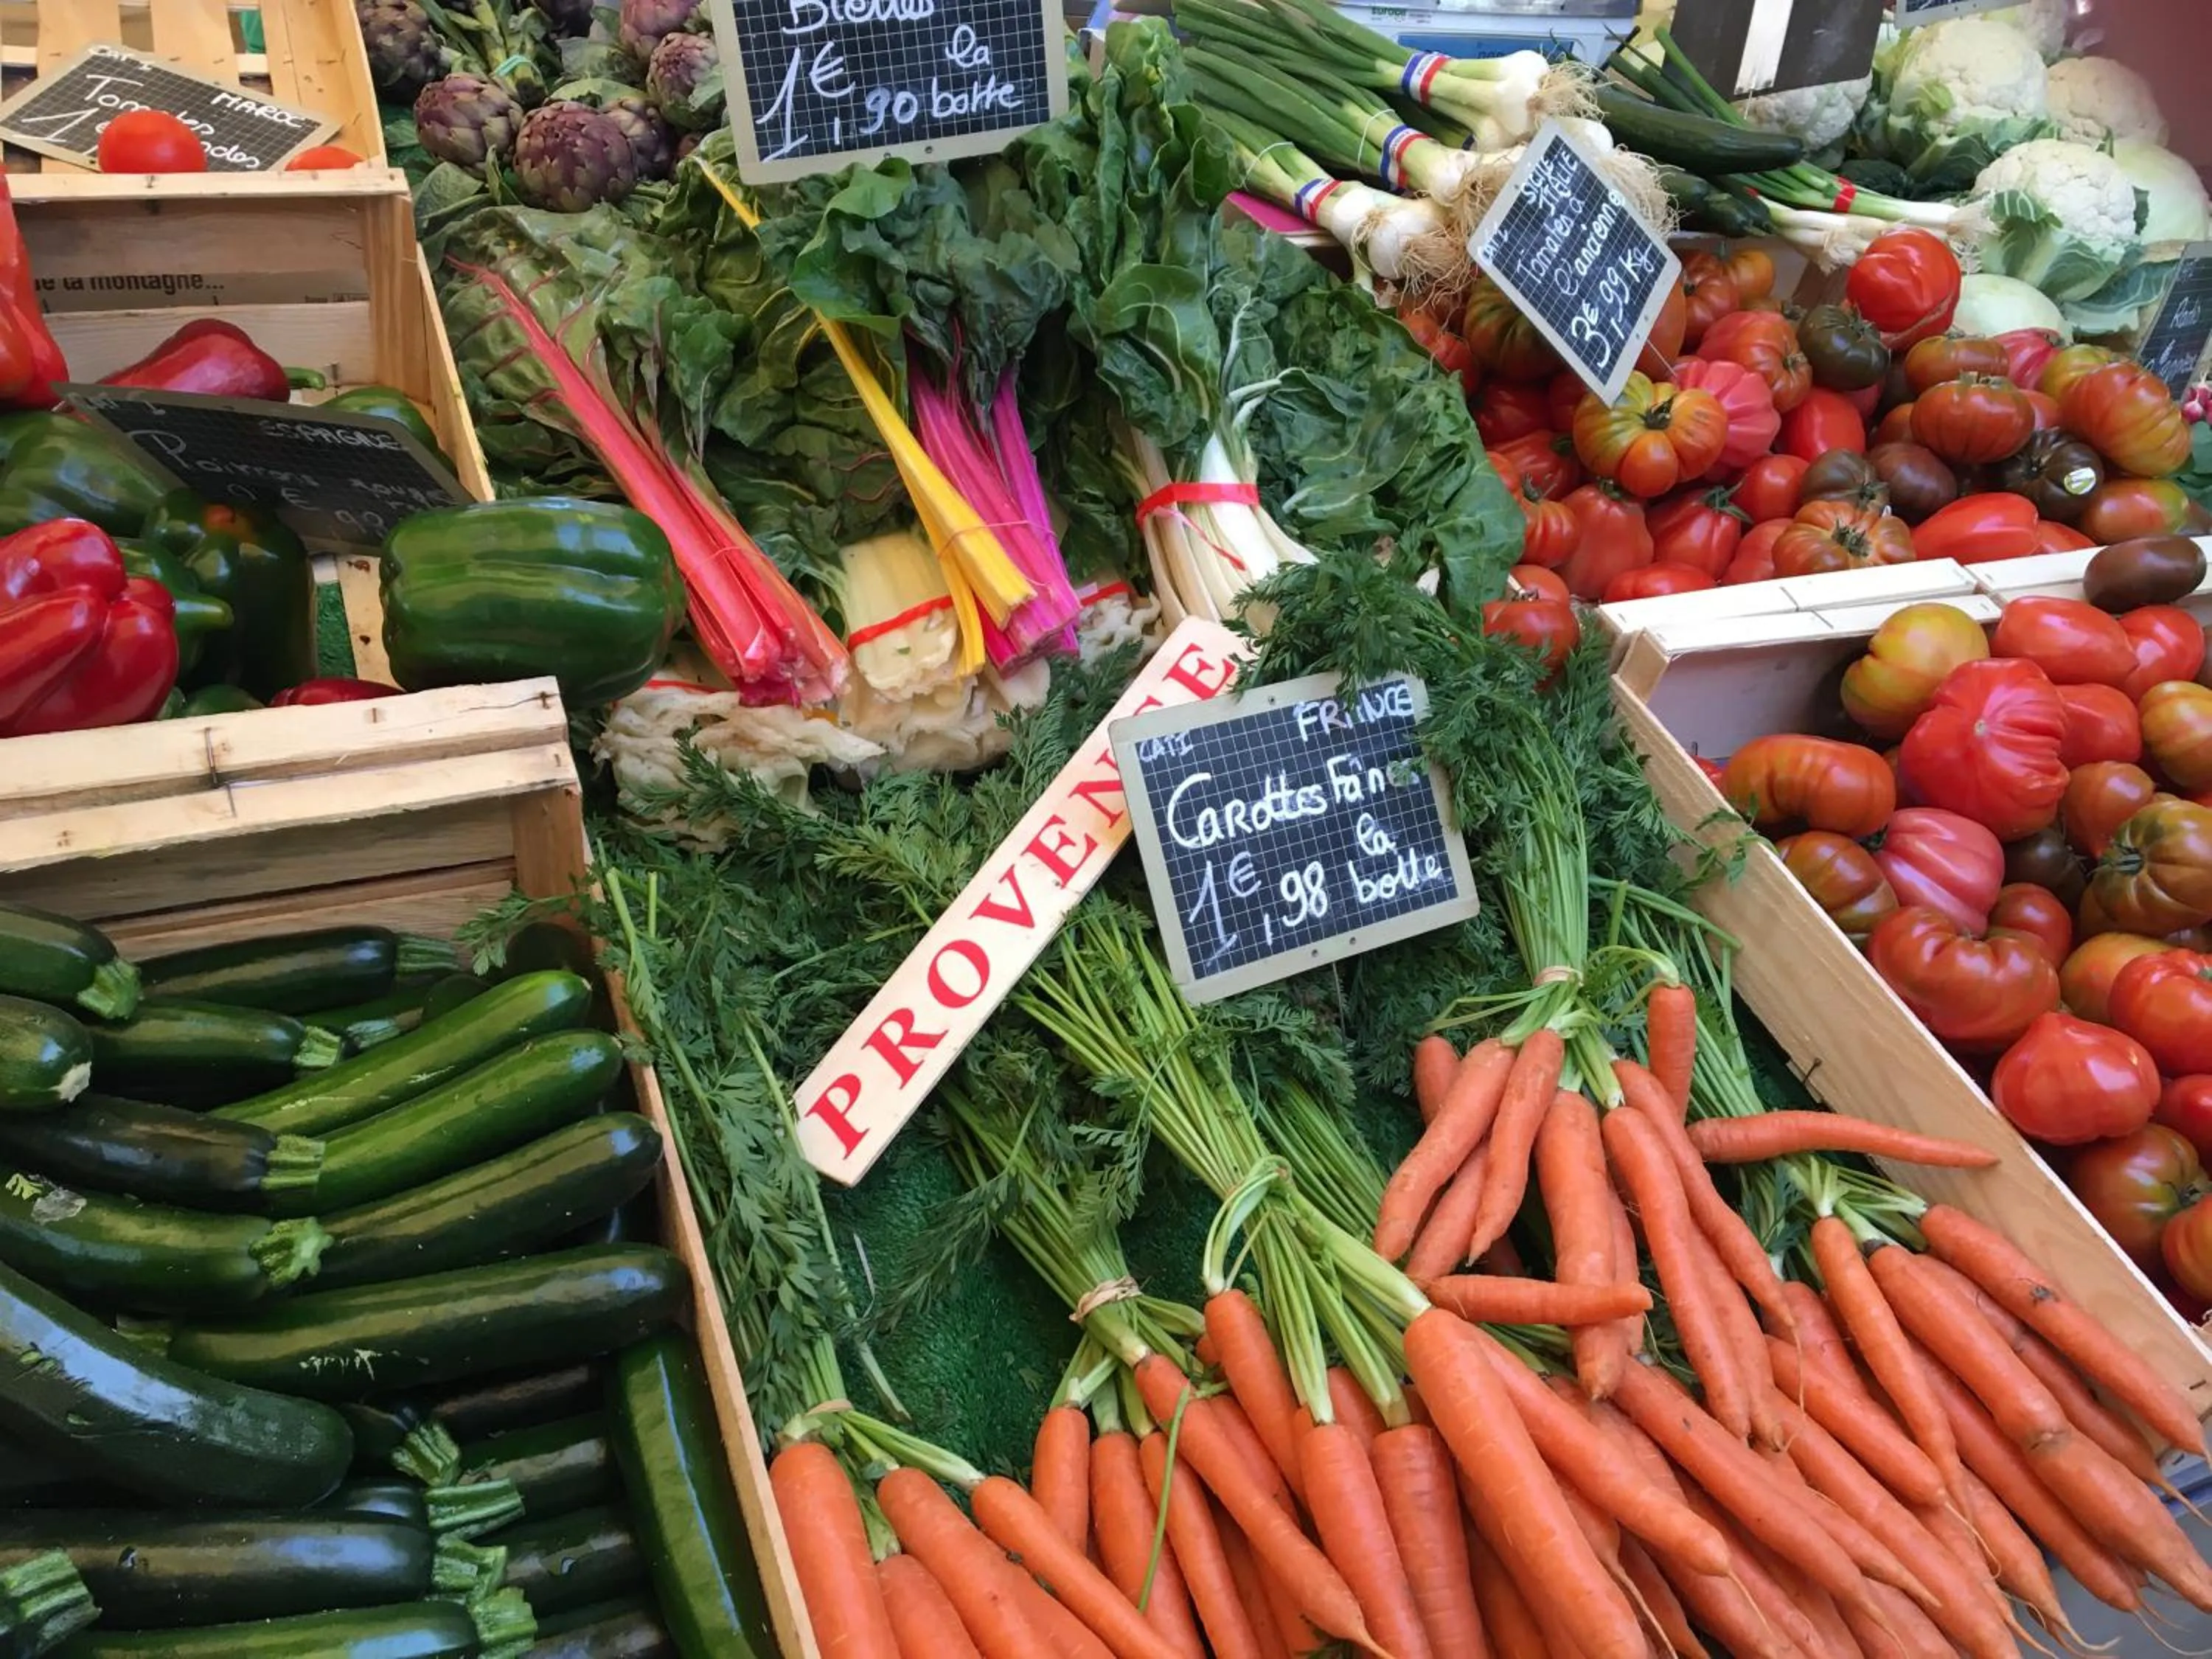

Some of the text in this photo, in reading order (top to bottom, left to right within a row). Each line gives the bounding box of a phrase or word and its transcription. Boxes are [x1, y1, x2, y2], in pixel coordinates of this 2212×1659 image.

[211, 91, 306, 128] MAROC
[1539, 150, 1579, 217] ITALIE
[805, 642, 1236, 1161] PROVENE
